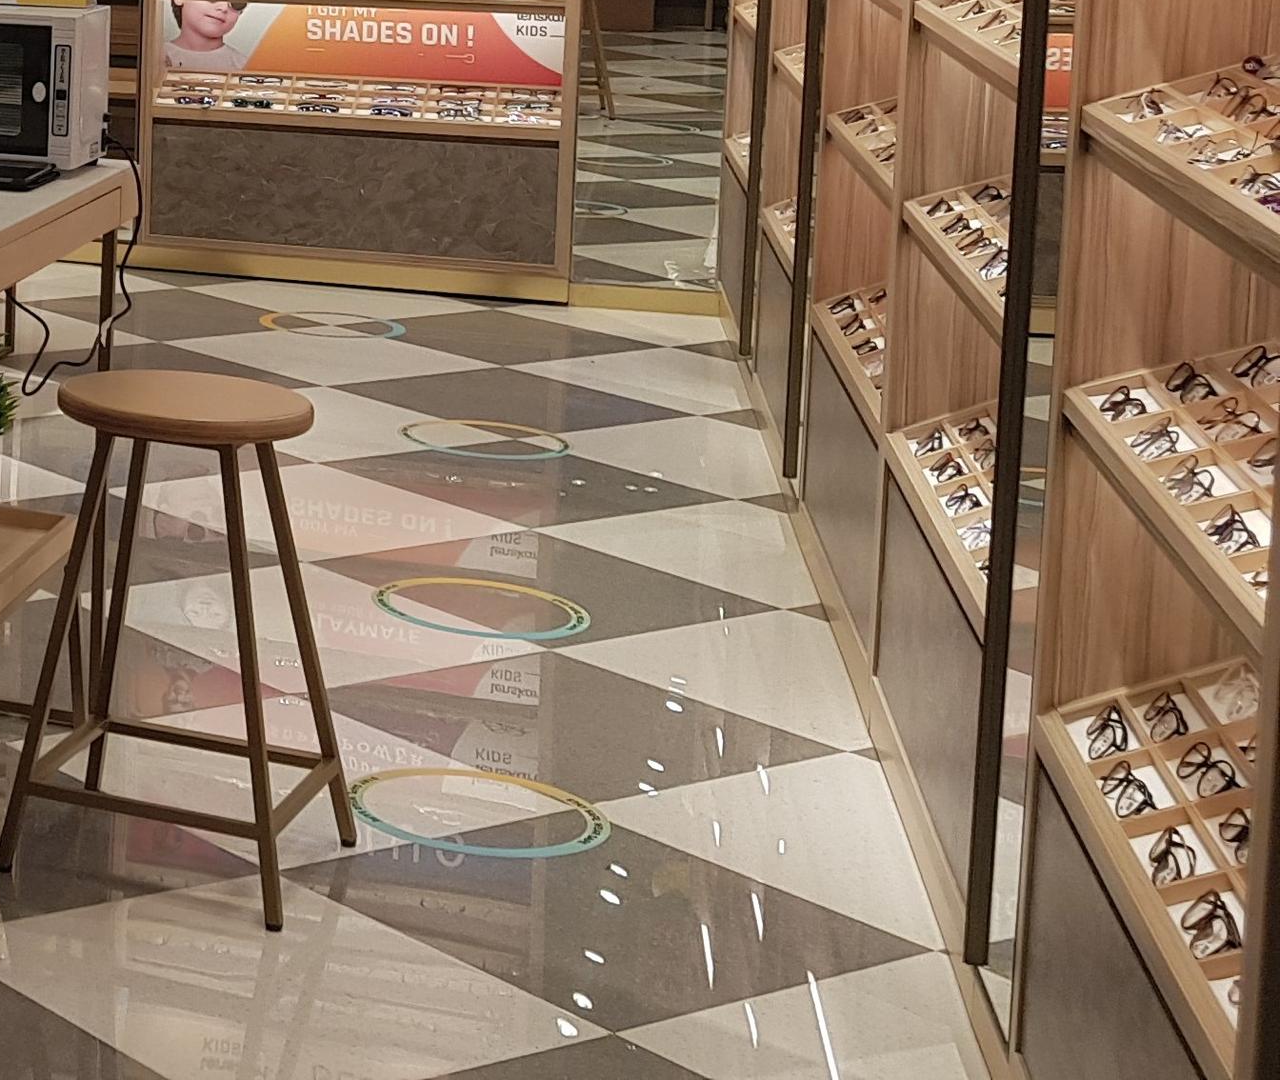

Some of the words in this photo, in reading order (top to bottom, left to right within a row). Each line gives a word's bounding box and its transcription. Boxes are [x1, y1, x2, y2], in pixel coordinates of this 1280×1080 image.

[306, 19, 413, 45] SHADES
[422, 23, 457, 46] ON
[516, 25, 548, 38] KIDS
